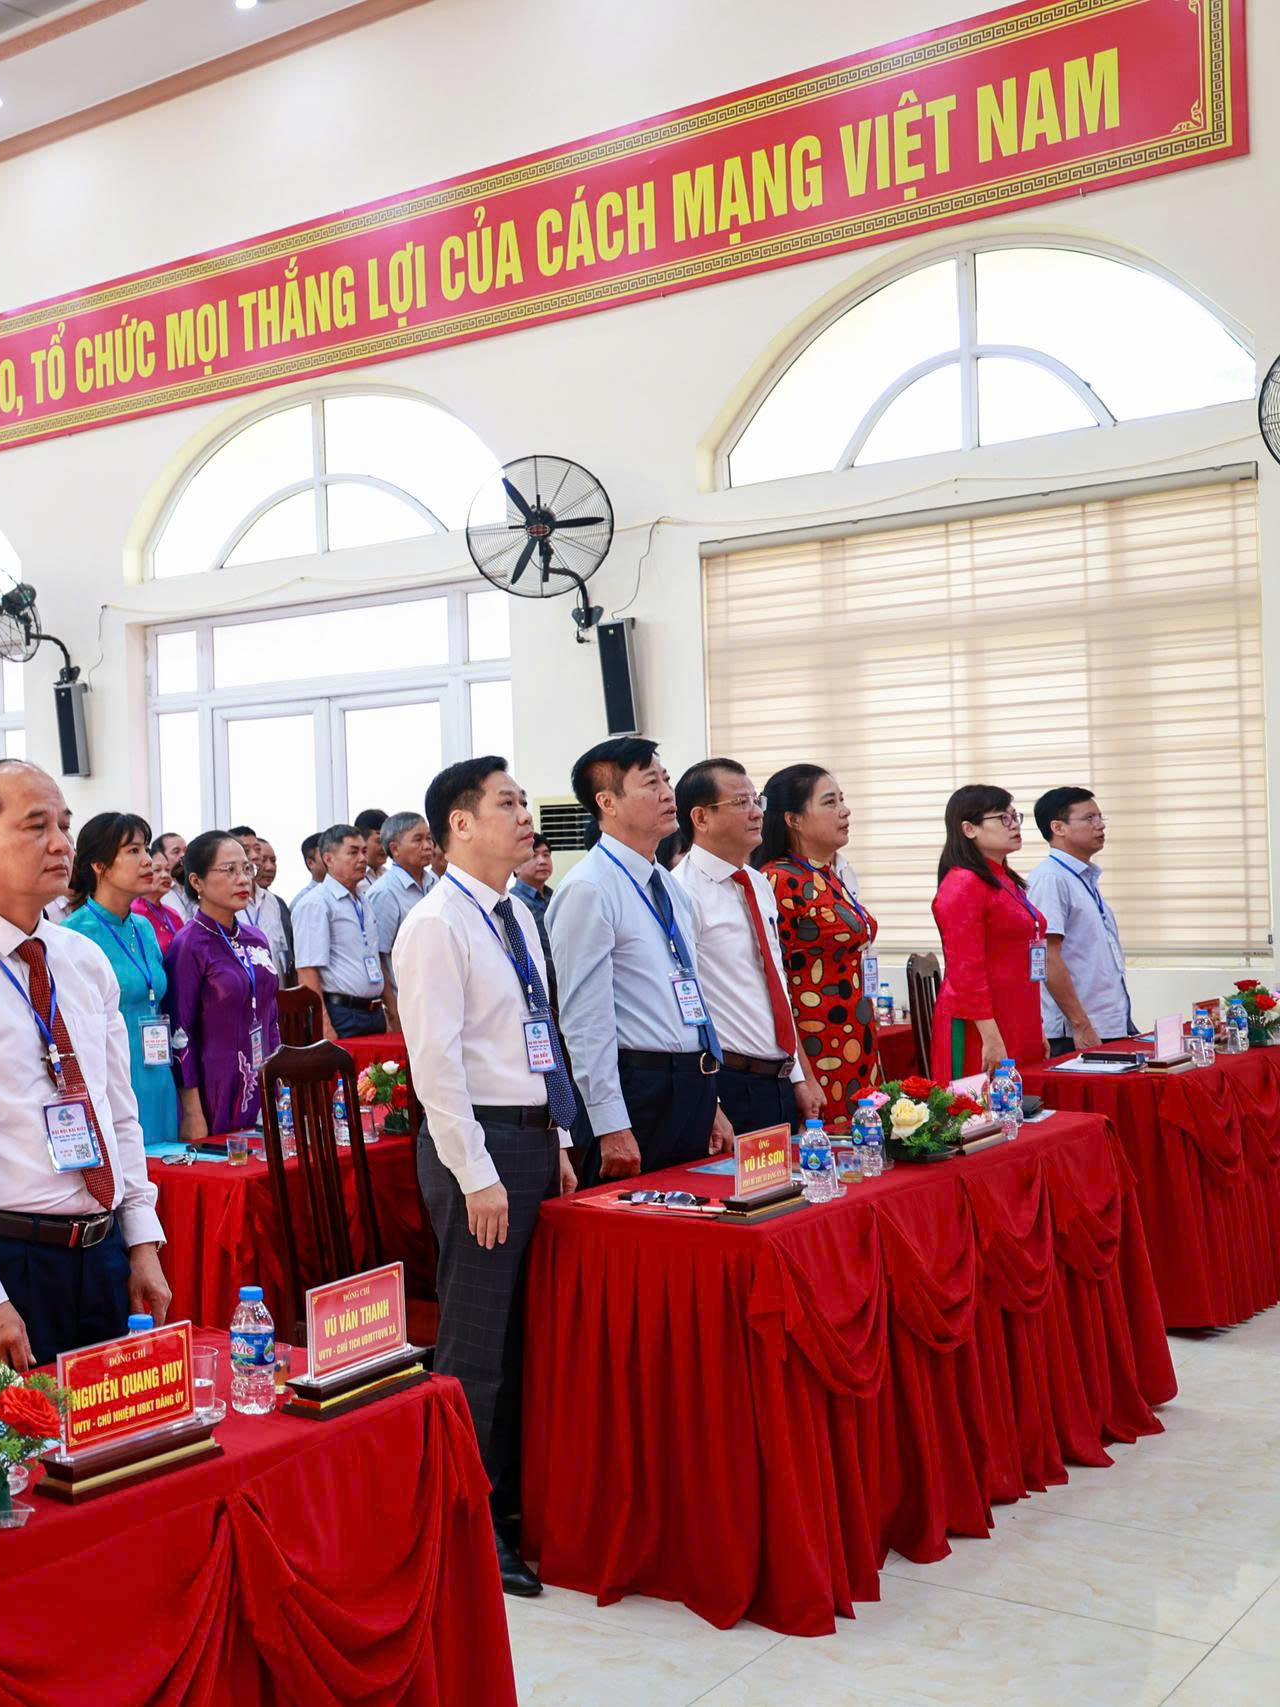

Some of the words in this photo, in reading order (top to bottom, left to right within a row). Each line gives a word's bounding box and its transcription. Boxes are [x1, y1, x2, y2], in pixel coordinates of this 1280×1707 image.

[31, 322, 66, 404] TỔ
[74, 313, 156, 393] CHỨC
[165, 299, 229, 376] MỌI
[238, 254, 356, 351] THẮNG
[367, 242, 428, 328] LỢI
[440, 205, 524, 302] CỦA
[535, 185, 658, 278] CÁCH
[671, 135, 824, 246] MẠNG
[838, 90, 958, 201] VIỆT
[976, 46, 1121, 164] NAM
[757, 1152, 766, 1168] LÊ
[324, 1313, 338, 1337] VŨ
[339, 1308, 359, 1333] VĂN
[359, 1298, 390, 1325] THANH
[109, 1351, 130, 1365] ĐỒNG
[132, 1346, 146, 1359] CHÍ
[71, 1372, 118, 1410] NGUYỄN
[121, 1366, 159, 1396] QUANG
[161, 1359, 183, 1384] HUY
[73, 1420, 90, 1434] UVTV
[97, 1409, 111, 1428] CHỦ
[112, 1403, 135, 1422] NHIỆM
